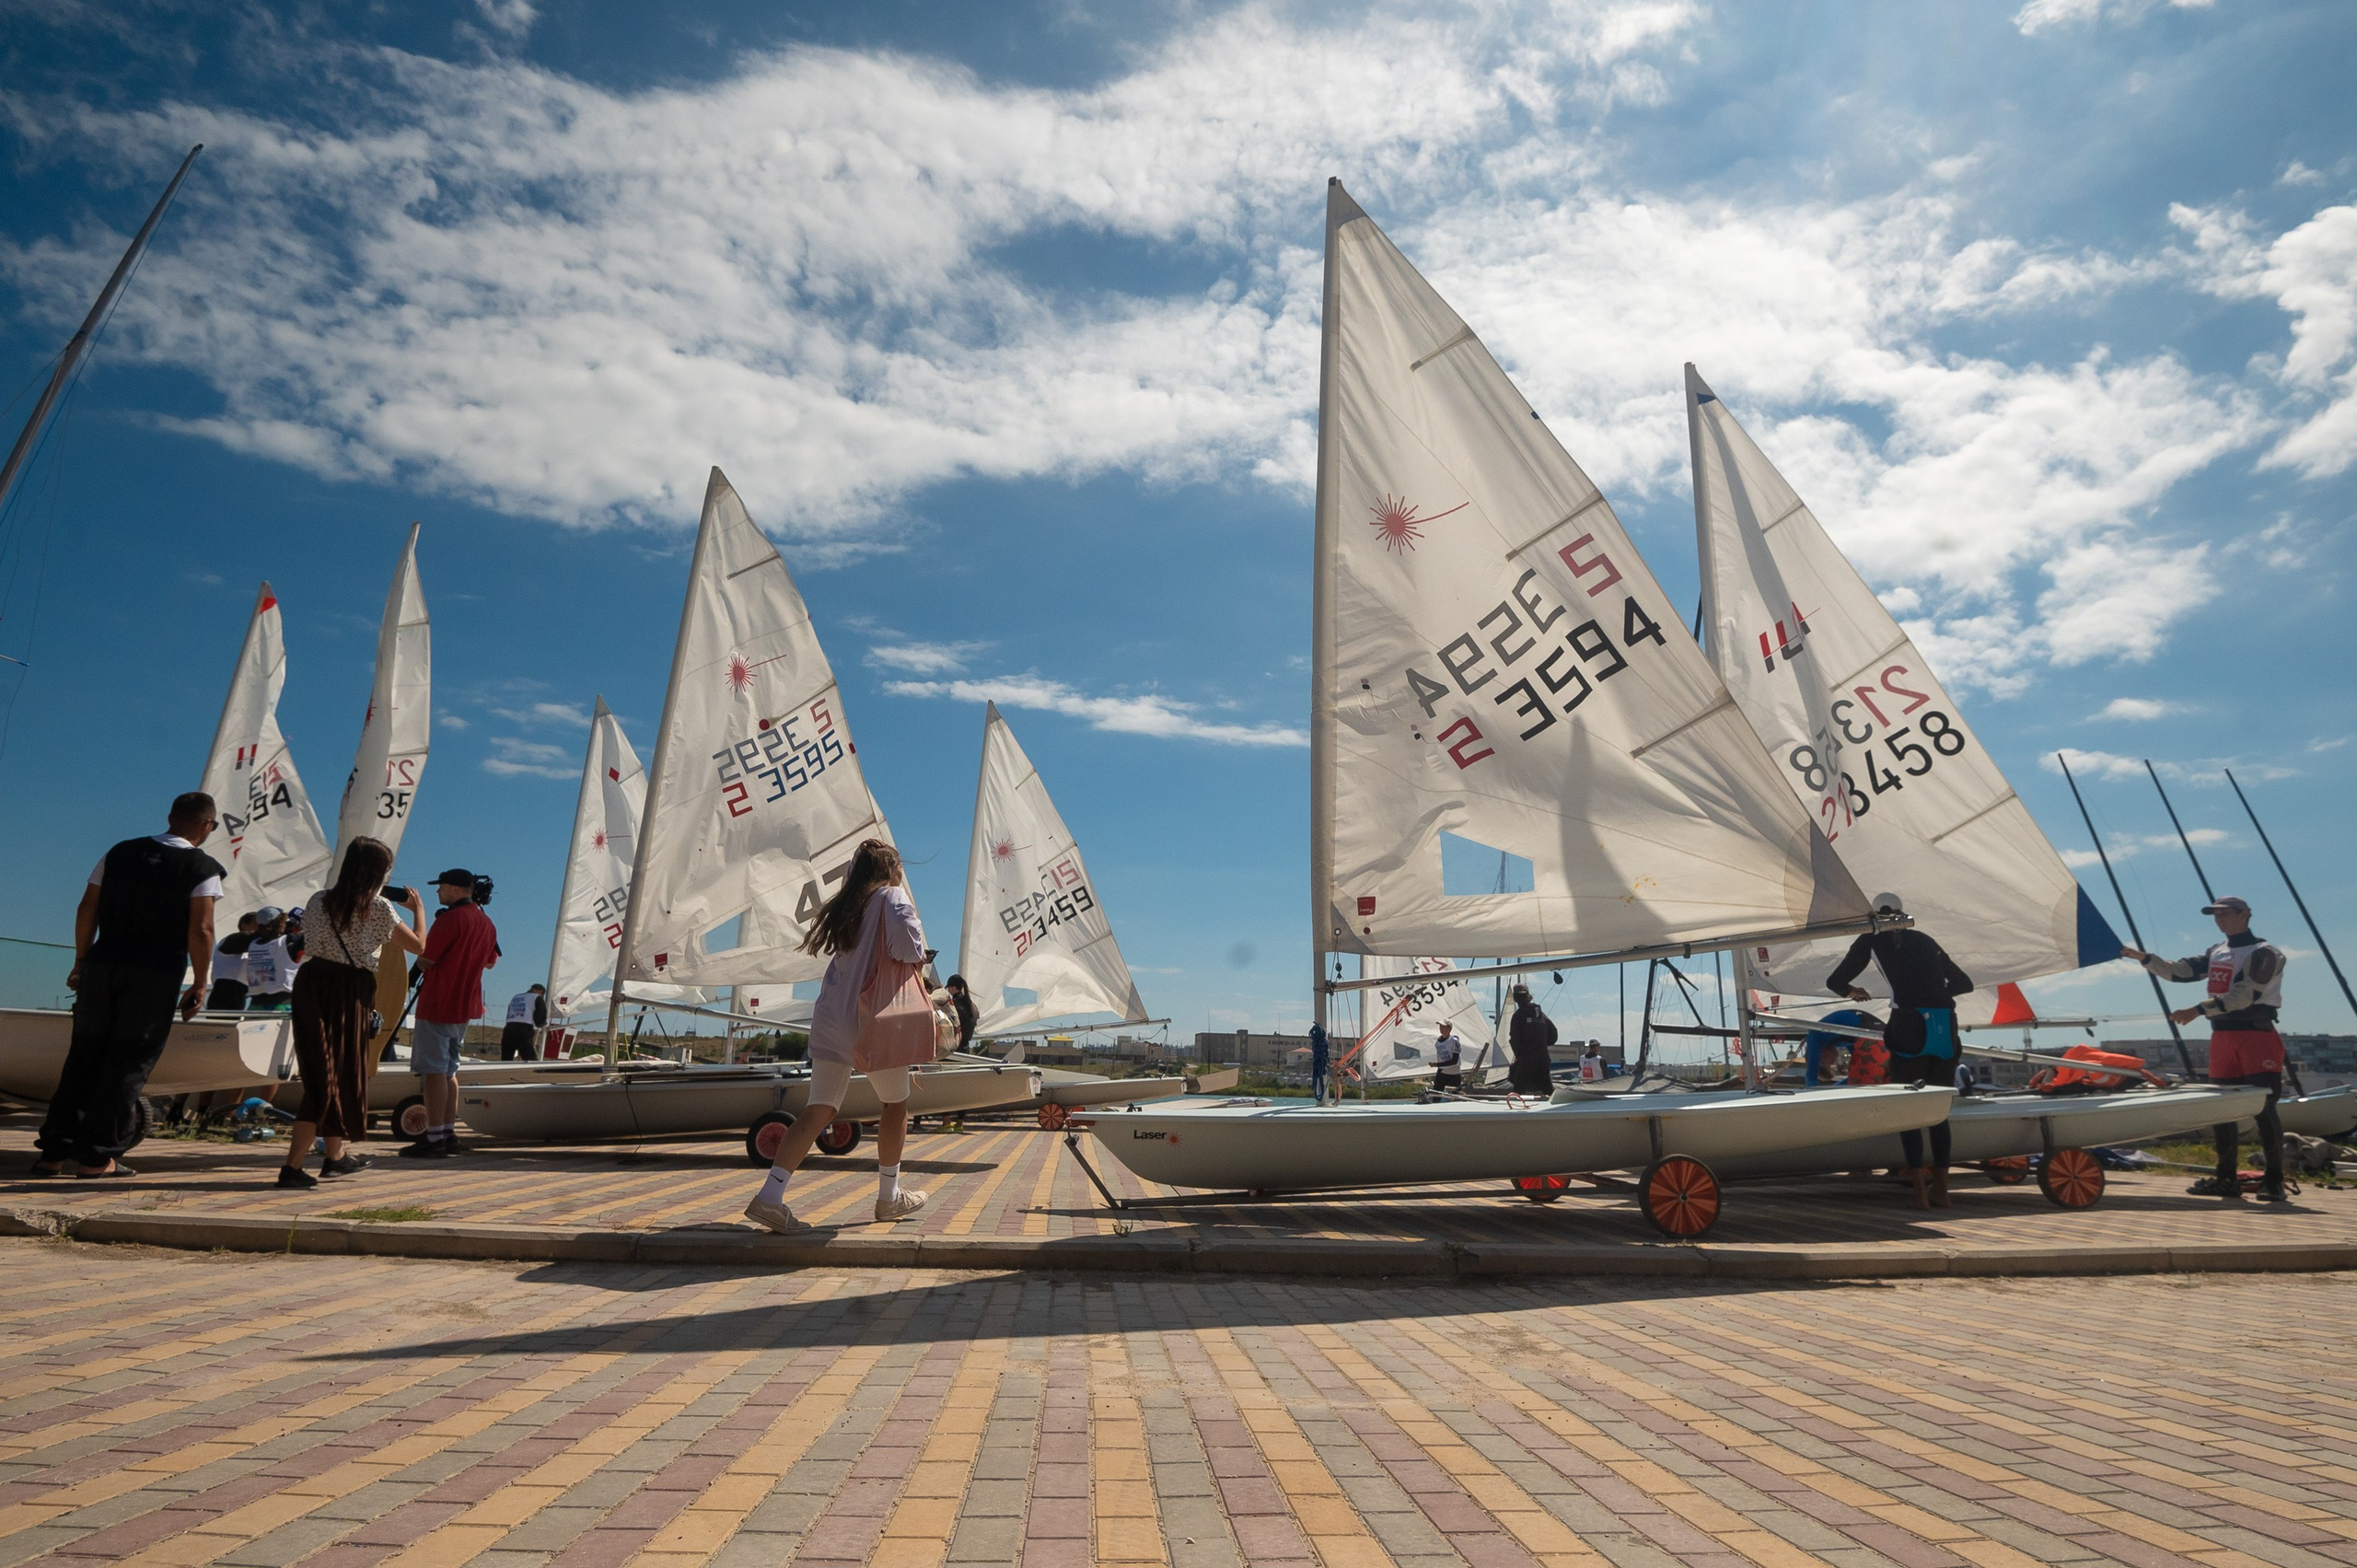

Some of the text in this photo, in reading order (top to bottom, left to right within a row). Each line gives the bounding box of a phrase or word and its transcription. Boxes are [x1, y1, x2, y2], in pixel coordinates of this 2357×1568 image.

[1437, 596, 1666, 770] 2 3594
[722, 729, 844, 819] 2 3595
[1133, 1130, 1167, 1140] Laser
